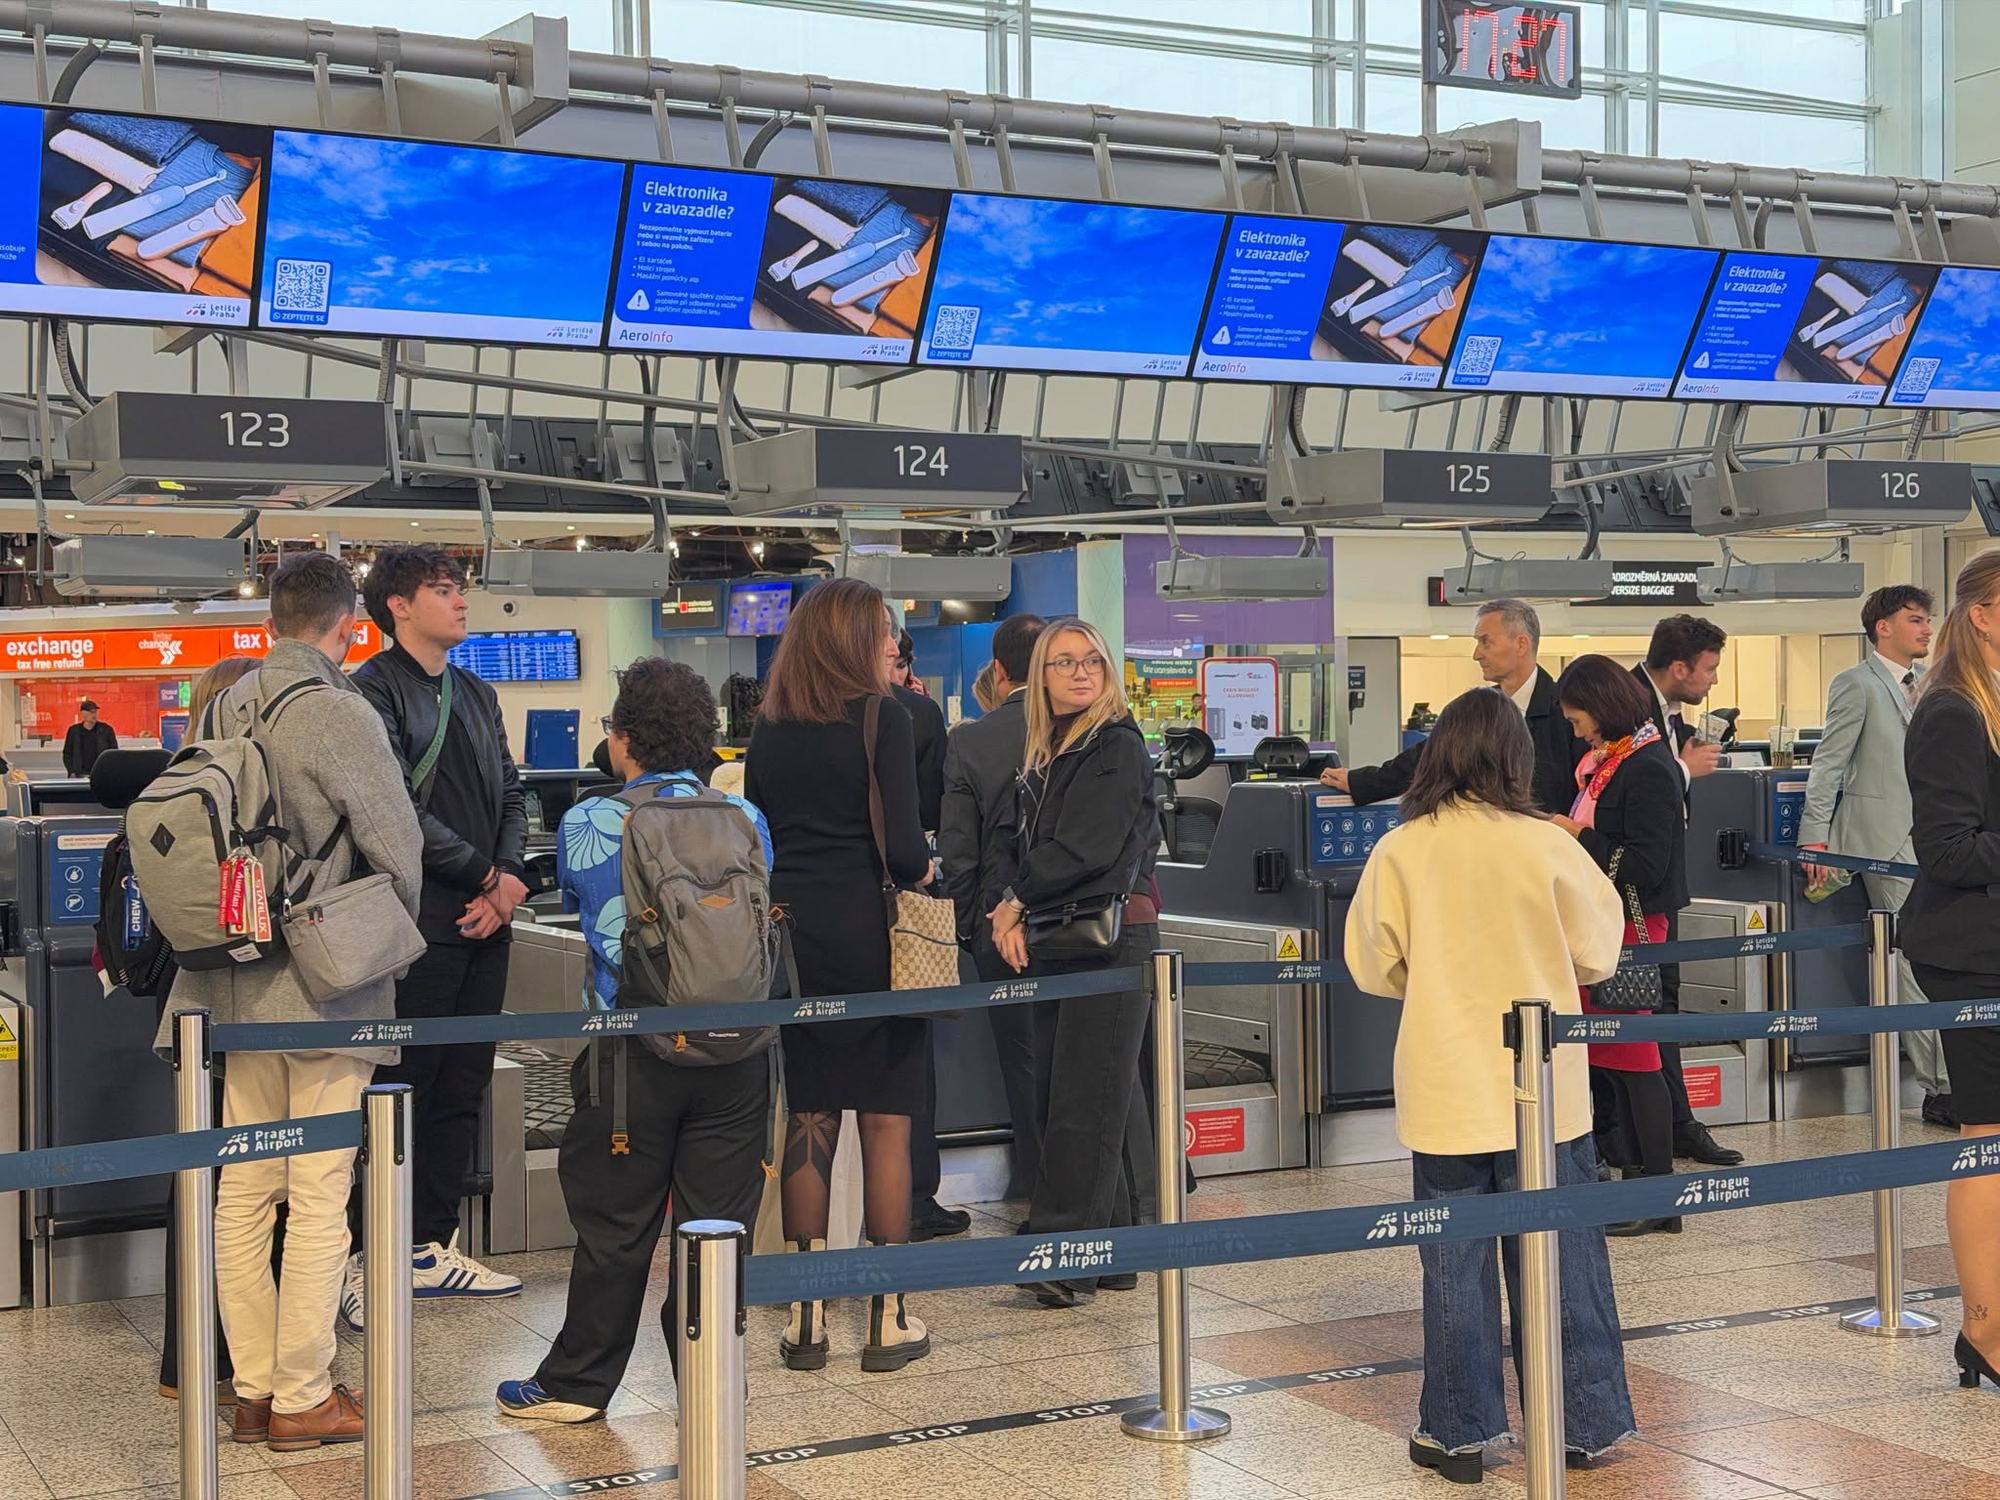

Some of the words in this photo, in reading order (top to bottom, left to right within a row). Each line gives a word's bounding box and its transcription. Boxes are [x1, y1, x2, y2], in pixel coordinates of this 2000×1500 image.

[1462, 8, 1566, 82] 17:27
[644, 181, 728, 202] Elektronika
[642, 202, 651, 213] v
[654, 202, 735, 219] zavazadle?
[1239, 230, 1306, 247] Elektronika
[1235, 248, 1243, 258] v
[1245, 249, 1310, 263] zavazadle?
[1729, 265, 1786, 280] Elektronika
[1732, 282, 1787, 294] zavazadle?
[210, 304, 241, 312] Letiště
[210, 310, 235, 319] Praha
[281, 313, 315, 322] ZEPTEJTE
[619, 329, 673, 343] AeroInfo
[1202, 361, 1246, 374] AeroInfo
[1681, 383, 1720, 394] AeroInfo
[221, 412, 289, 446] 123
[893, 446, 949, 477] 124
[1447, 465, 1490, 493] 125
[1881, 473, 1920, 498] 126
[1661, 572, 1699, 583] ZAVAZADL
[1641, 585, 1675, 596] BAGGAGE
[138, 639, 170, 651] change
[233, 630, 262, 650] tax
[6, 636, 94, 659] exchange
[16, 660, 31, 670] tax
[33, 658, 51, 669] free
[53, 657, 84, 669] refund
[232, 872, 244, 907] Austrian
[255, 879, 267, 933] STARLUX
[131, 898, 141, 932] CREW
[1296, 964, 1321, 973] Prague
[1296, 971, 1321, 980] Airport
[1010, 981, 1038, 991] Letiště
[1010, 989, 1034, 998] Praha
[815, 1007, 846, 1016] Airport
[816, 1001, 846, 1009] Prague
[606, 1013, 639, 1022] Letiště
[1789, 1016, 1818, 1025] Prague
[1975, 1012, 1997, 1020] Praha
[378, 1025, 413, 1034] Prague
[606, 1021, 633, 1029] Praha
[1590, 1020, 1621, 1030] Letiště
[1788, 1023, 1818, 1033] Airport
[377, 1032, 413, 1041] Airport
[1590, 1028, 1616, 1037] Praha
[254, 1127, 304, 1142] Prague
[254, 1137, 304, 1153] Airport
[1981, 1153, 2000, 1167] Pra
[1707, 1176, 1750, 1191] Prague
[1706, 1187, 1750, 1203] Airport
[1403, 1206, 1450, 1224] Letiště
[1403, 1220, 1443, 1237] Praha
[1060, 1238, 1113, 1256] Prague
[1058, 1252, 1113, 1271] Airport
[1769, 1306, 1831, 1319] STOP
[1664, 1319, 1728, 1333] STOP
[1306, 1367, 1376, 1382] STOP
[1035, 1404, 1112, 1421] STOP
[889, 1425, 969, 1444] STOP
[569, 1471, 657, 1492] STOP
